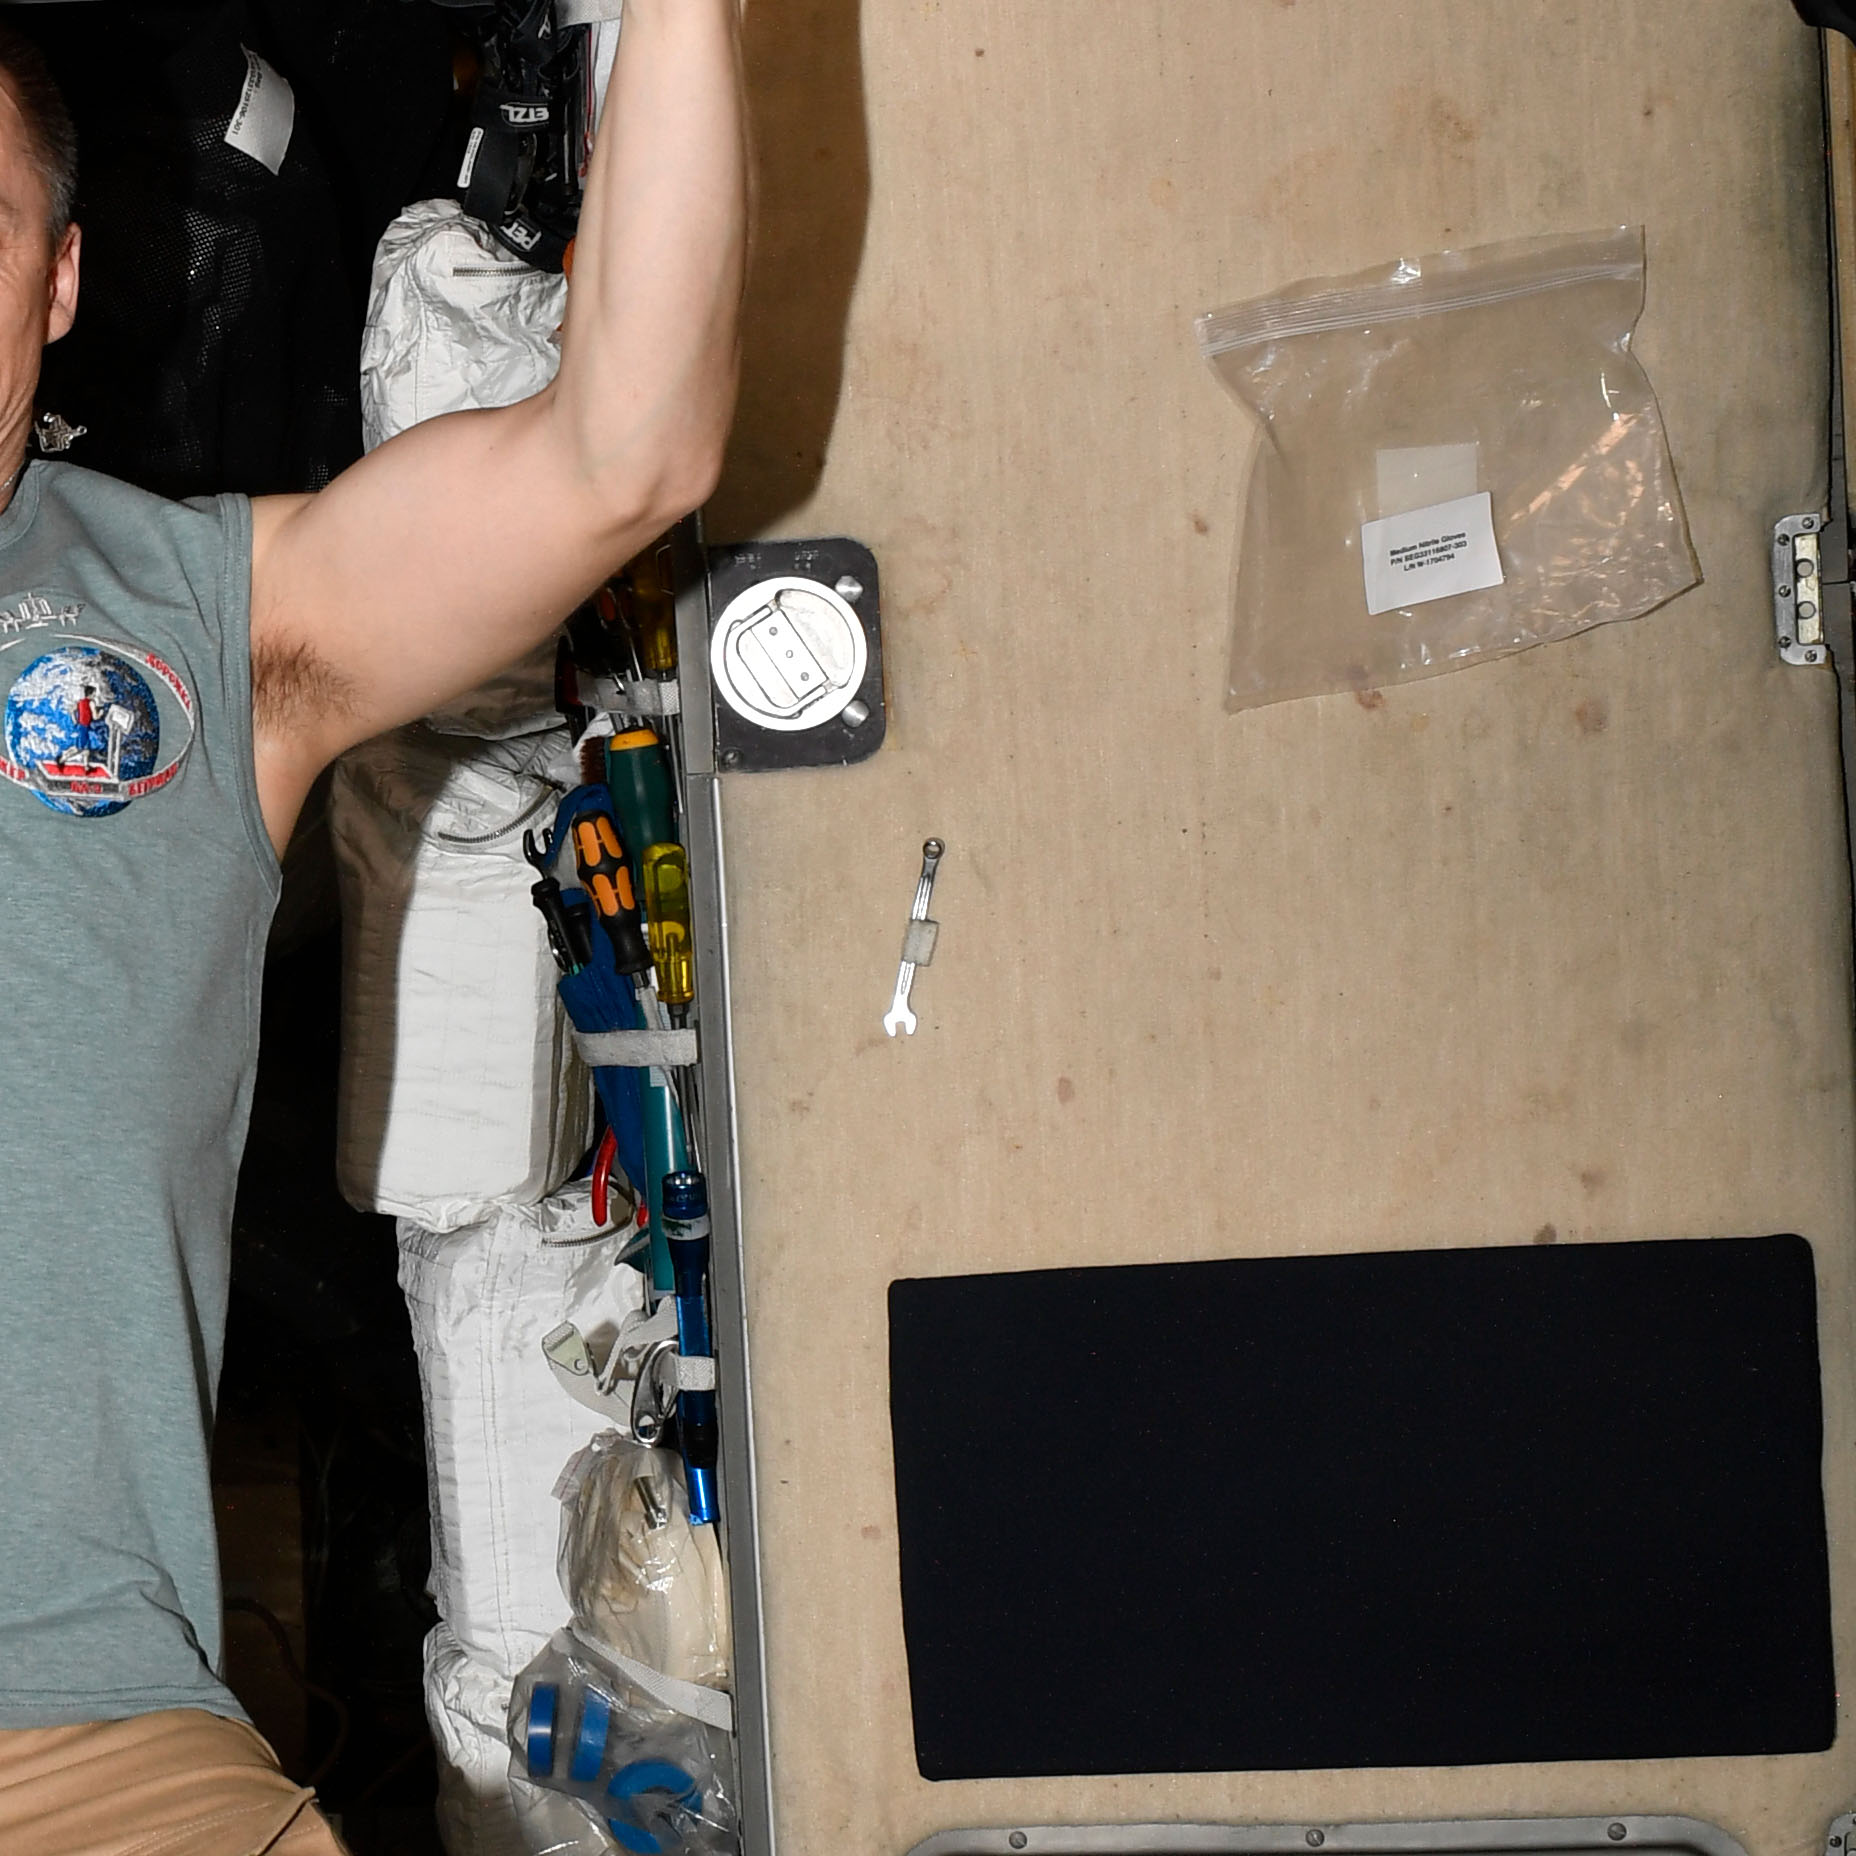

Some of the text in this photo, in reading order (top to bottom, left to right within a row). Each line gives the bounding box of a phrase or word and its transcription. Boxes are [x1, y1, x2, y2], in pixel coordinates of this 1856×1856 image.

[1390, 531, 1466, 557] Medium Nitrile Gloves
[1390, 555, 1403, 566] P/N
